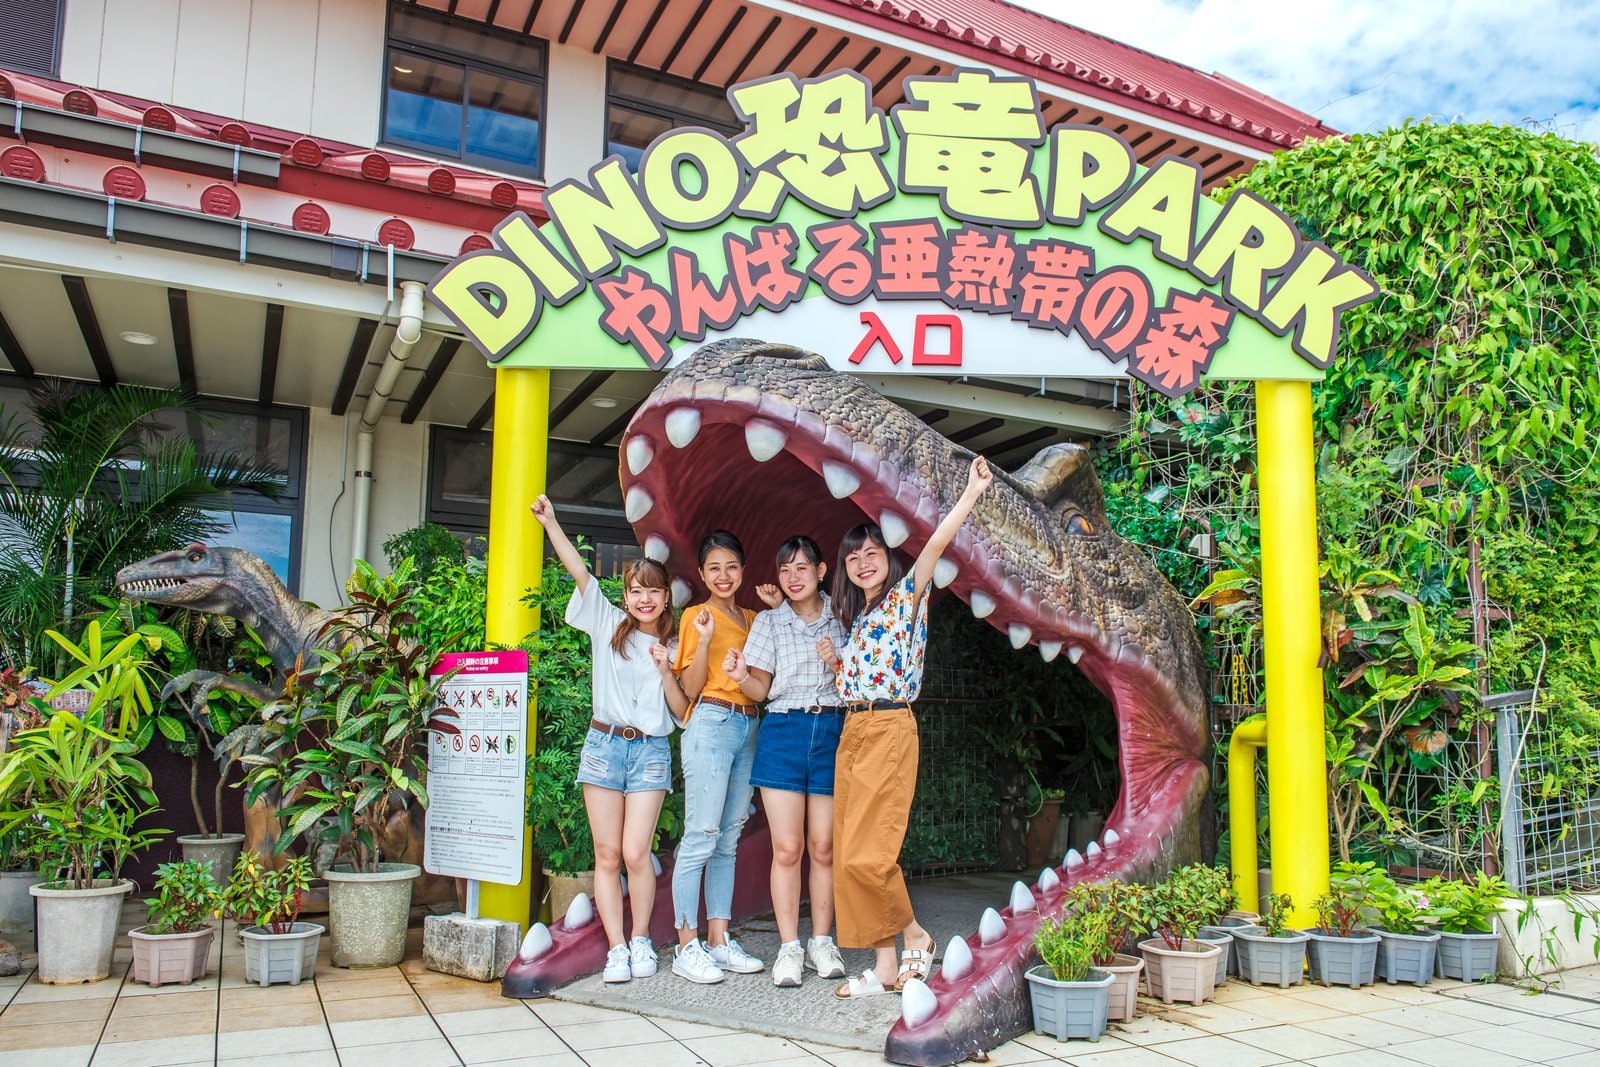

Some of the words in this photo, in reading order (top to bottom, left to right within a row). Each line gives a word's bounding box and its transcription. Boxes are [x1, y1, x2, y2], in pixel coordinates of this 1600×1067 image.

[429, 69, 1378, 368] DINO恐竜PARK
[595, 221, 1234, 394] やんばる亜熱帯の森
[848, 311, 963, 366] 入口
